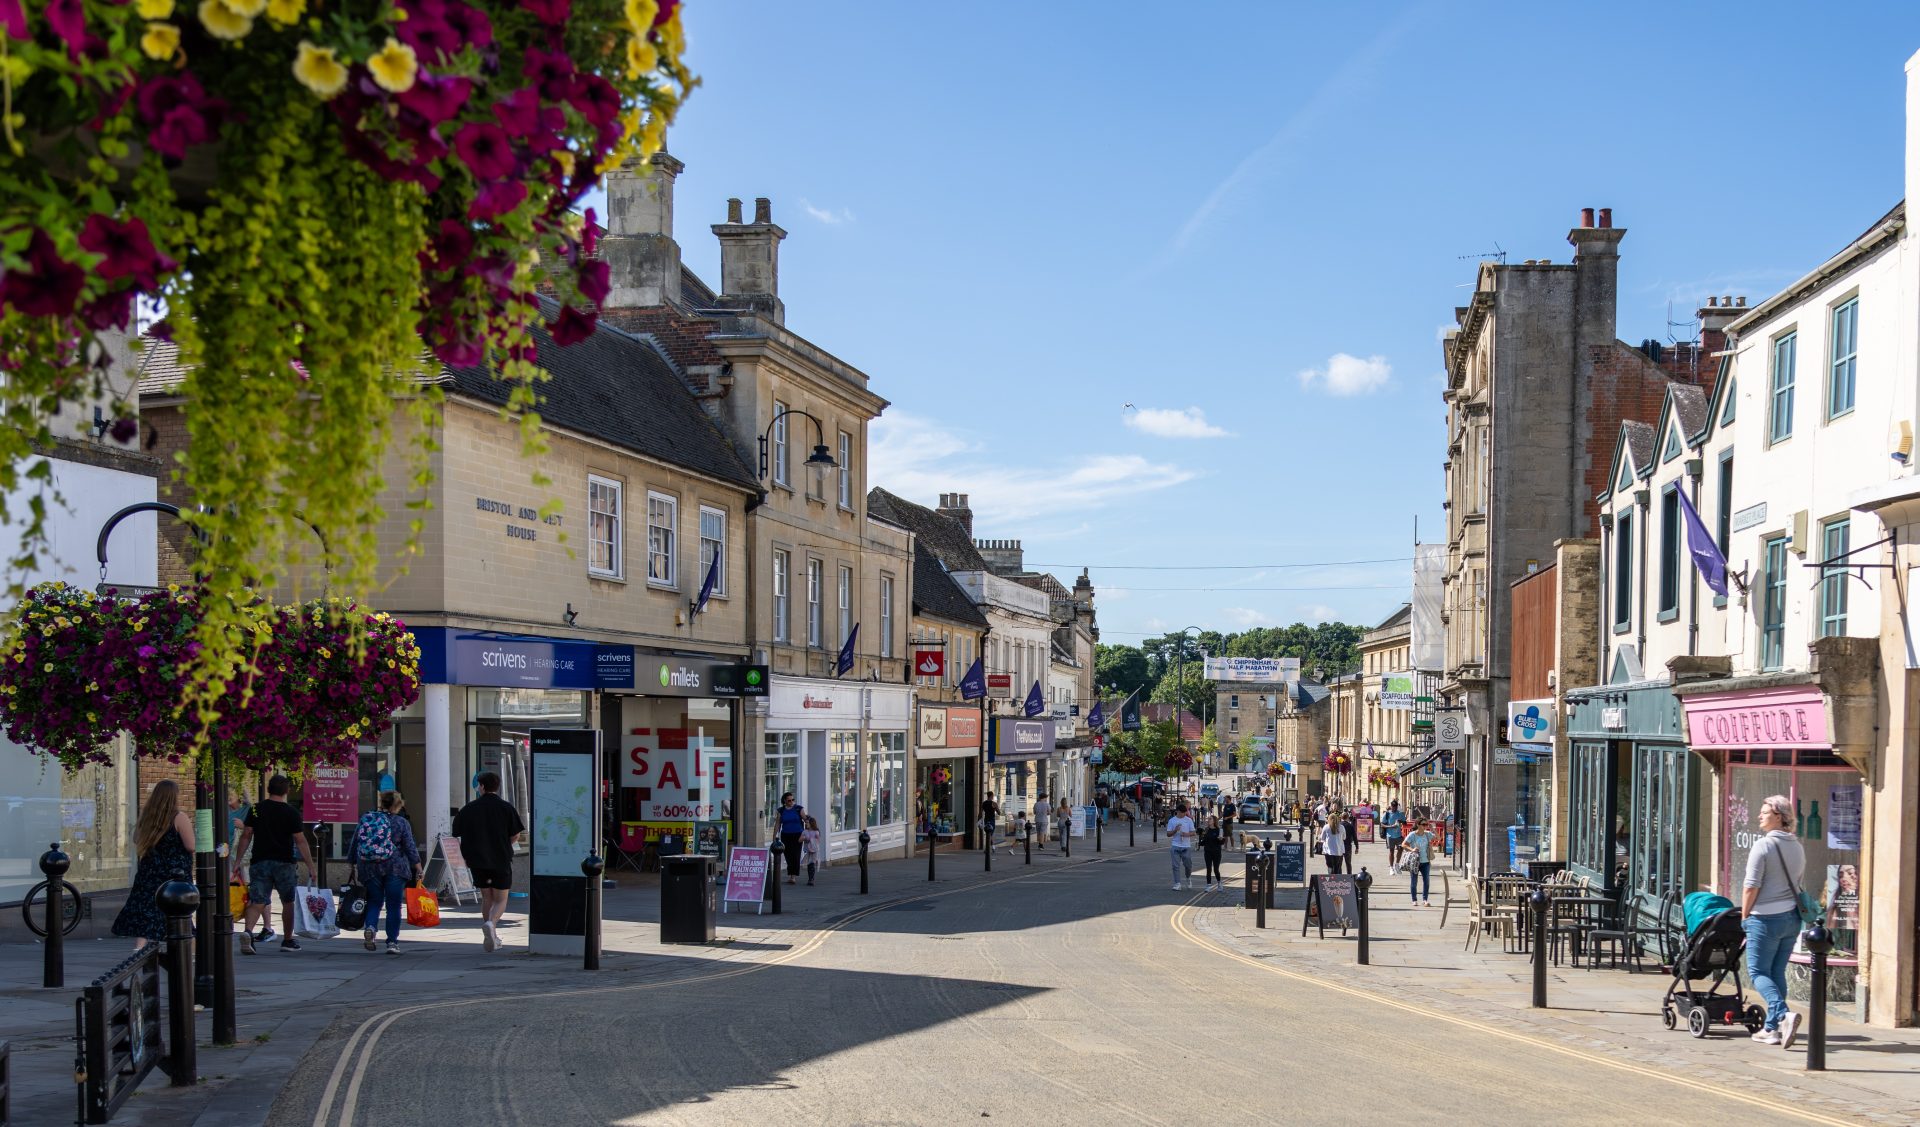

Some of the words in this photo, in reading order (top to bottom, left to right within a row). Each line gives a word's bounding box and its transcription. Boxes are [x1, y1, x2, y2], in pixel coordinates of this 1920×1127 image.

[477, 497, 513, 516] BRISTOL
[518, 507, 537, 521] AND
[506, 524, 536, 541] HOUSE
[482, 647, 526, 669] scrivens
[533, 659, 559, 669] HEARING
[560, 660, 575, 670] CARE
[597, 653, 631, 662] scrivens
[670, 666, 700, 688] millets
[1382, 692, 1413, 700] SCAFFOLDIN
[1441, 717, 1459, 739] 3
[1517, 720, 1537, 728] CROSS
[1703, 709, 1810, 744] COIFFURE
[631, 747, 726, 789] SALE
[663, 805, 693, 817] 60%
[695, 805, 714, 817] OFF
